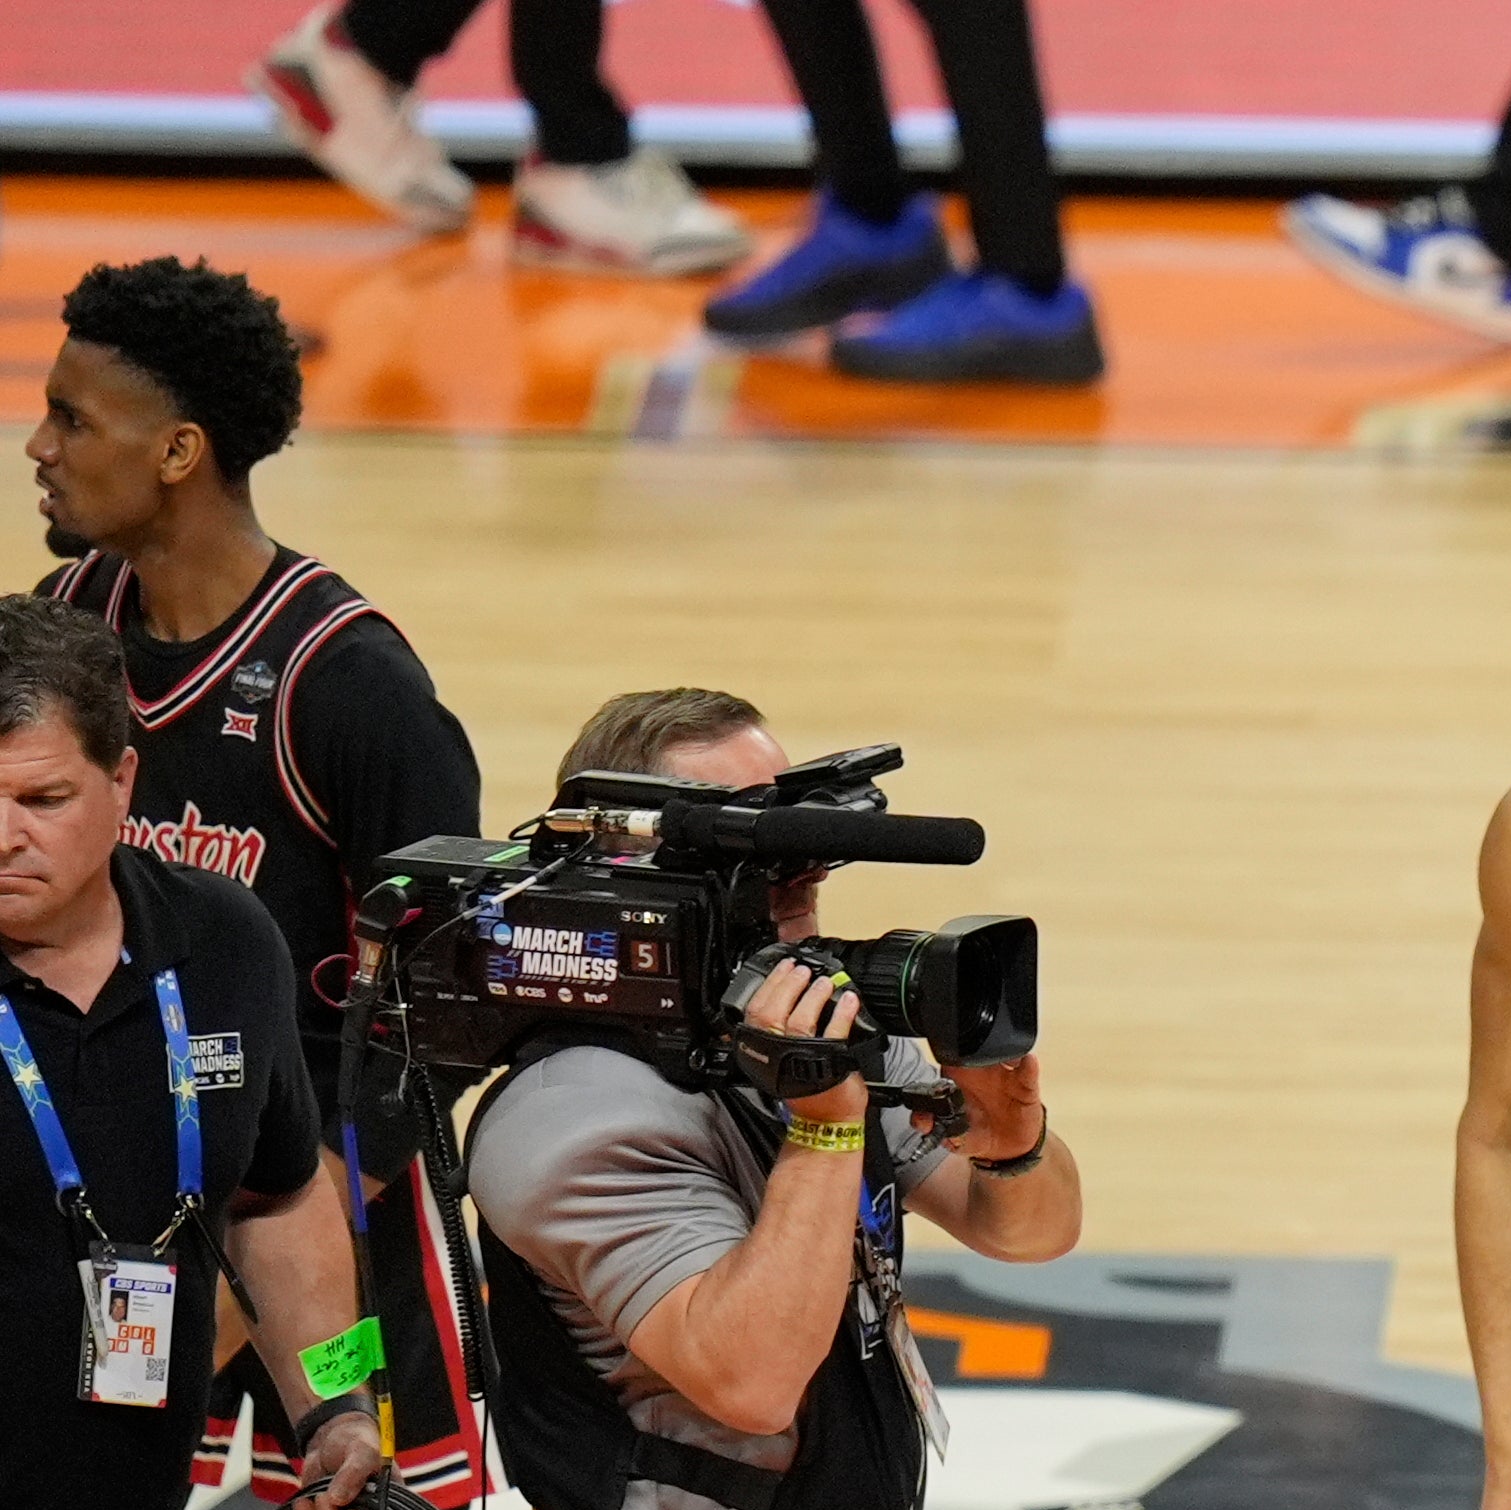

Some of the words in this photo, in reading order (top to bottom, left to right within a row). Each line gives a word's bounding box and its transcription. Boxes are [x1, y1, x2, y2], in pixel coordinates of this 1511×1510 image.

[117, 799, 267, 889] uston
[620, 911, 668, 924] SONY
[512, 926, 584, 955] MARCH
[522, 952, 620, 982] MADNESS
[637, 944, 655, 969] 5
